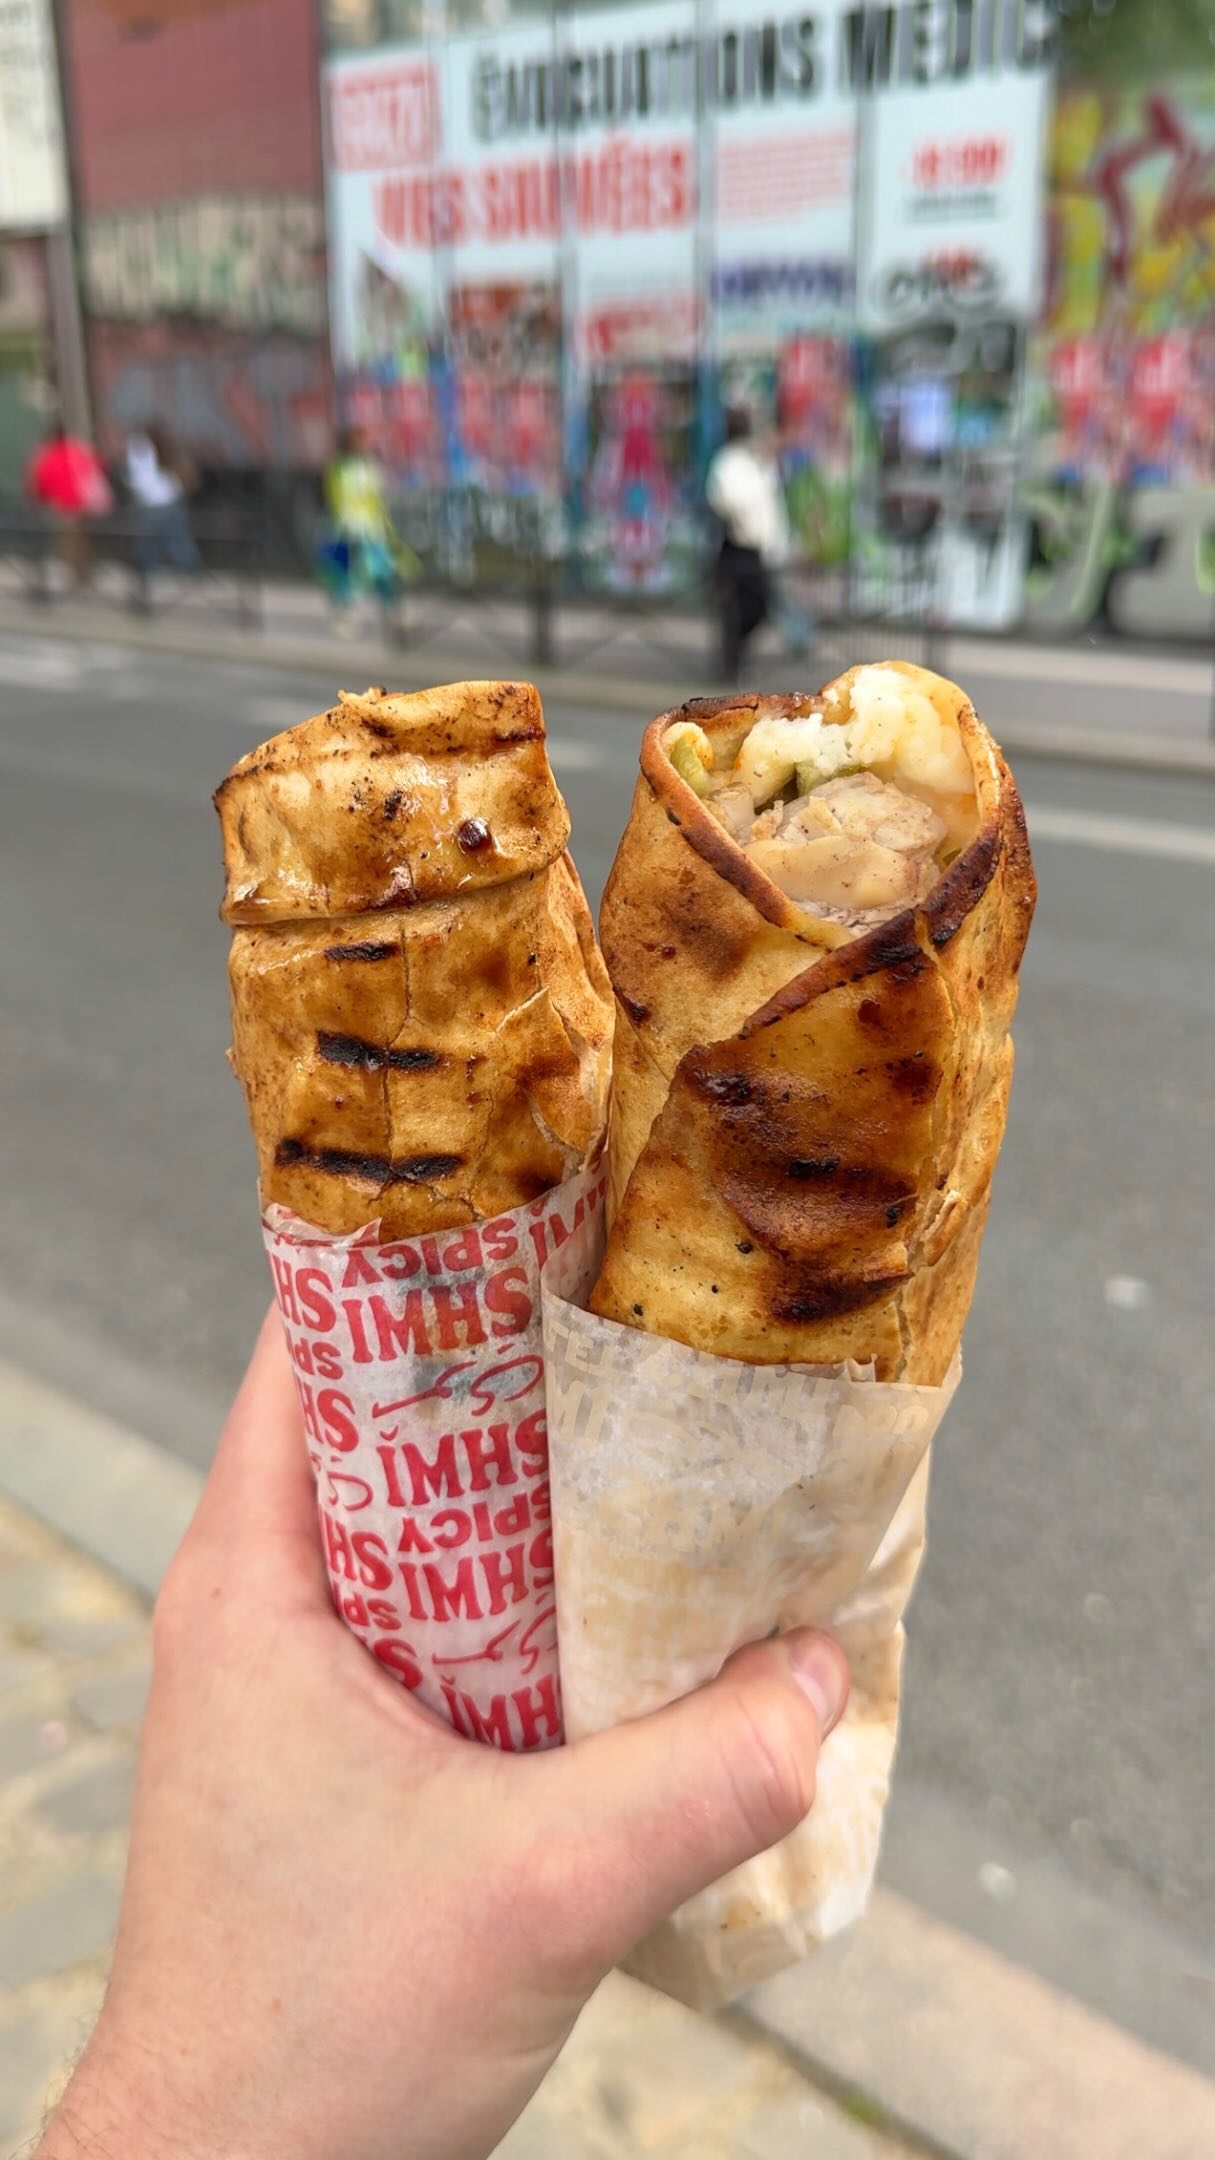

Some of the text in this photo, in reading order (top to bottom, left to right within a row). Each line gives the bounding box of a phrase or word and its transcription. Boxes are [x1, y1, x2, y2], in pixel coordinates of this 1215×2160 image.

[341, 1217, 519, 1289] SPICY
[341, 1266, 533, 1364] SHWI
[440, 1674, 563, 1751] HWI
